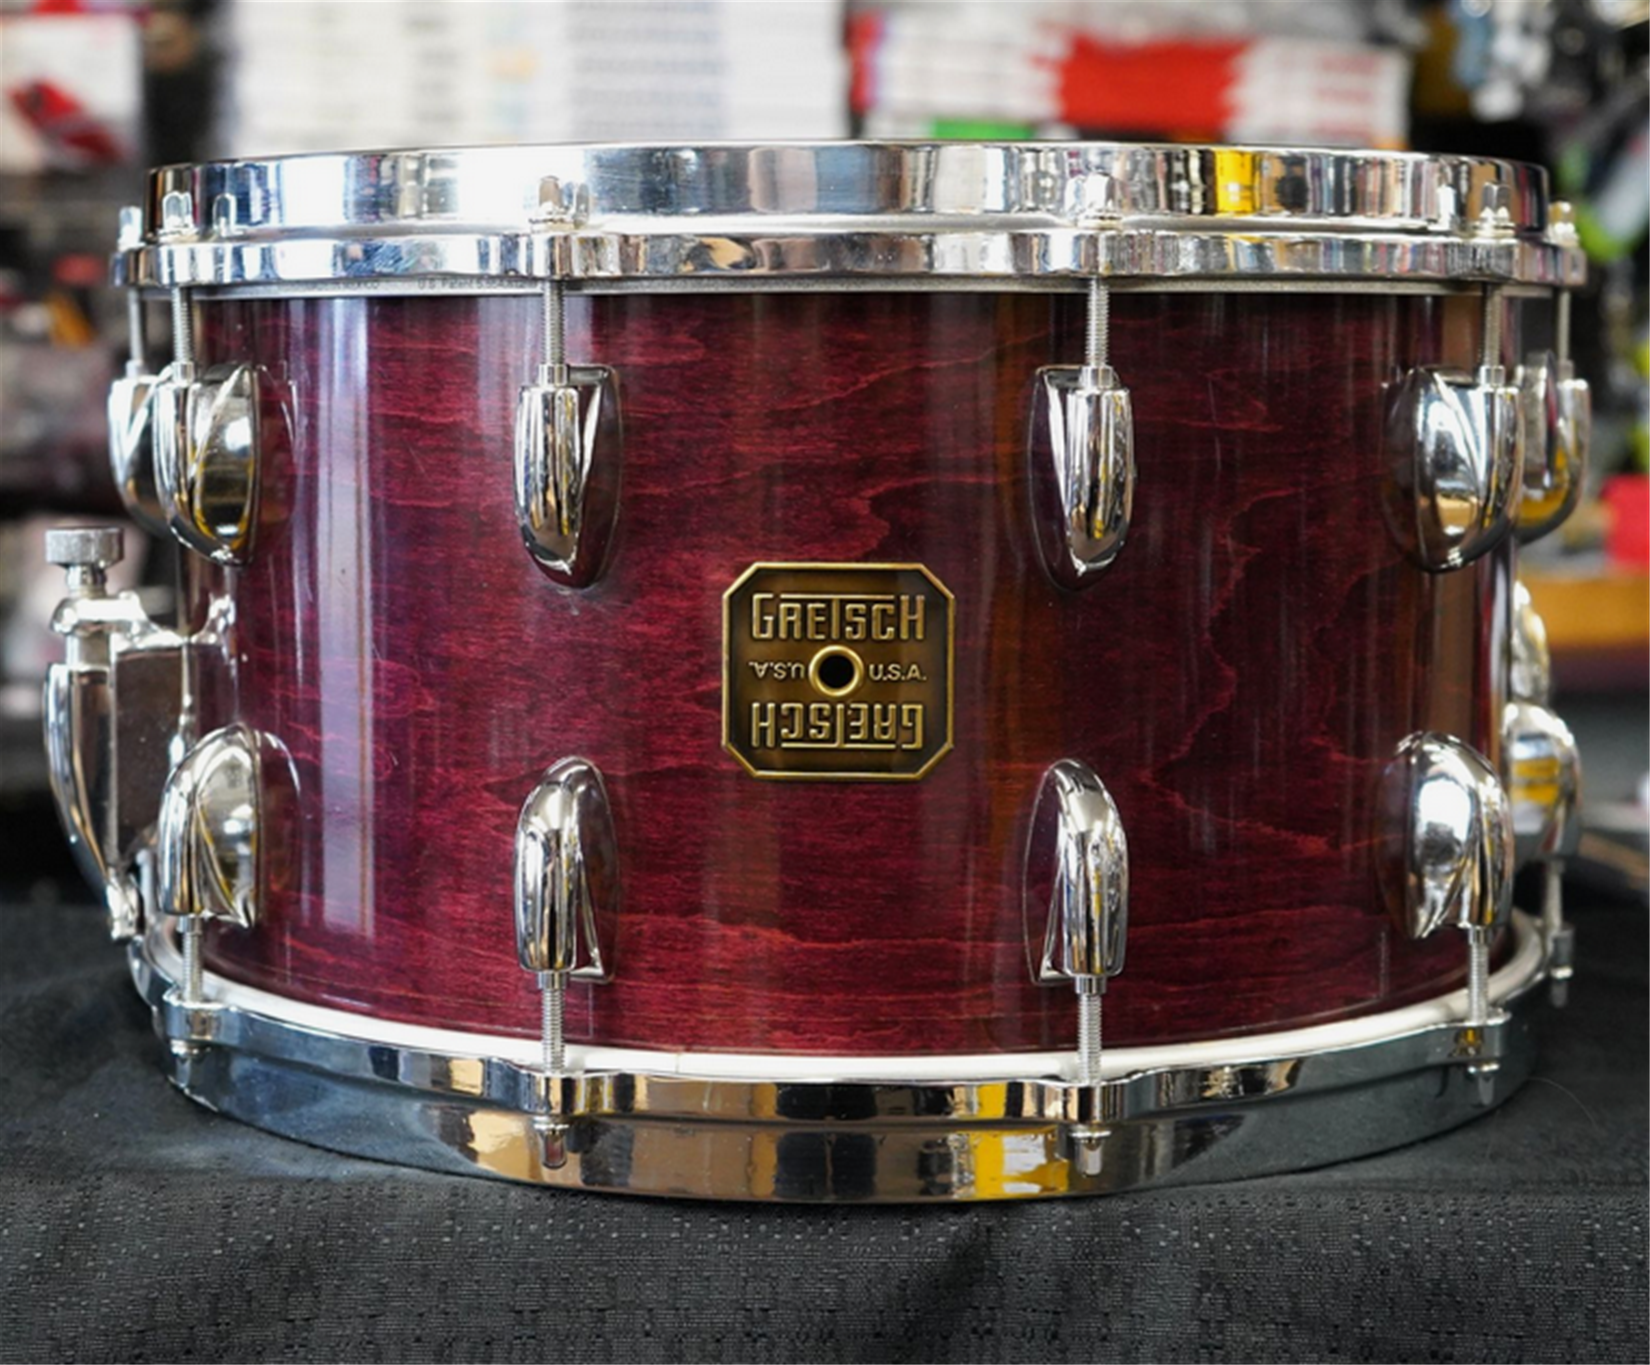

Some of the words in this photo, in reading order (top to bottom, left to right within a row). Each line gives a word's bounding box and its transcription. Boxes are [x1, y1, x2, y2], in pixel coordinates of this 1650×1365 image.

[752, 593, 925, 640] GRETSCH
[749, 661, 805, 680] U.S.A.
[868, 663, 927, 681] U.S.A.
[752, 702, 924, 749] GRETSCH
